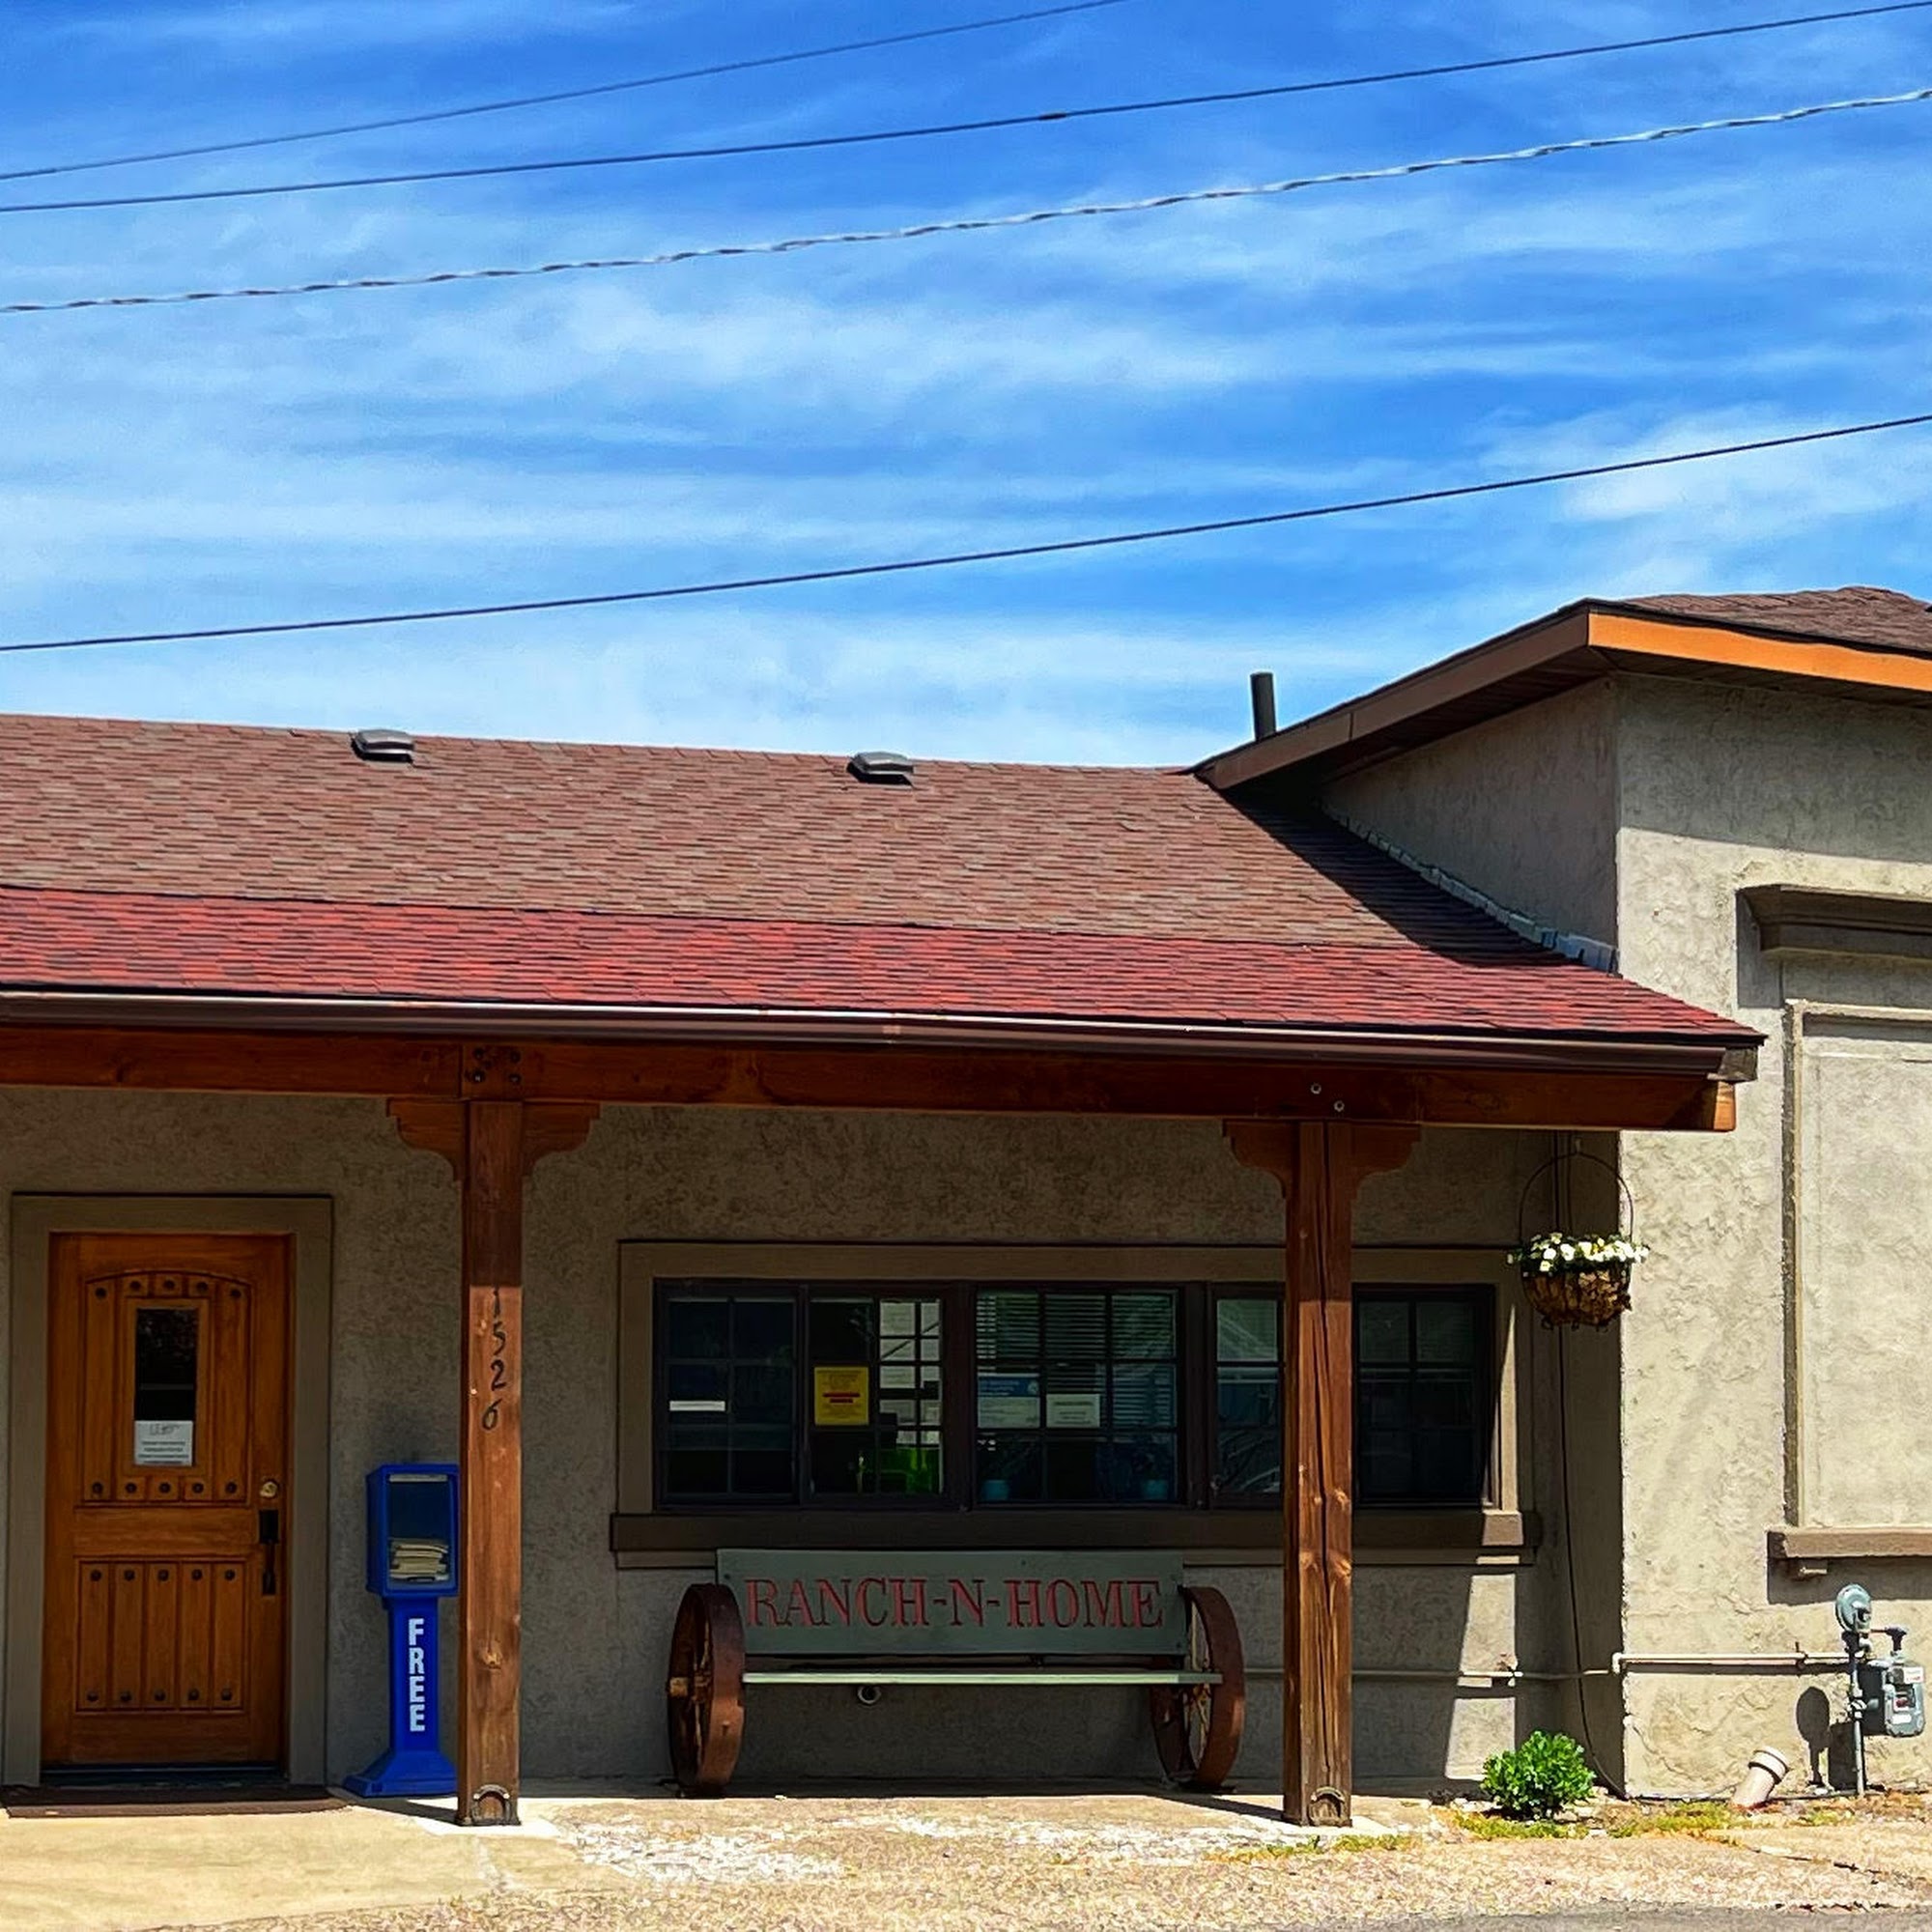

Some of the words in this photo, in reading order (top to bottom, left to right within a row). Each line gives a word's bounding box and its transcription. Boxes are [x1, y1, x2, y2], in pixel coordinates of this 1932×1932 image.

[482, 1285, 507, 1431] 1526
[745, 1578, 1163, 1628] RANCH-N-HOME
[409, 1618, 425, 1732] FREE
